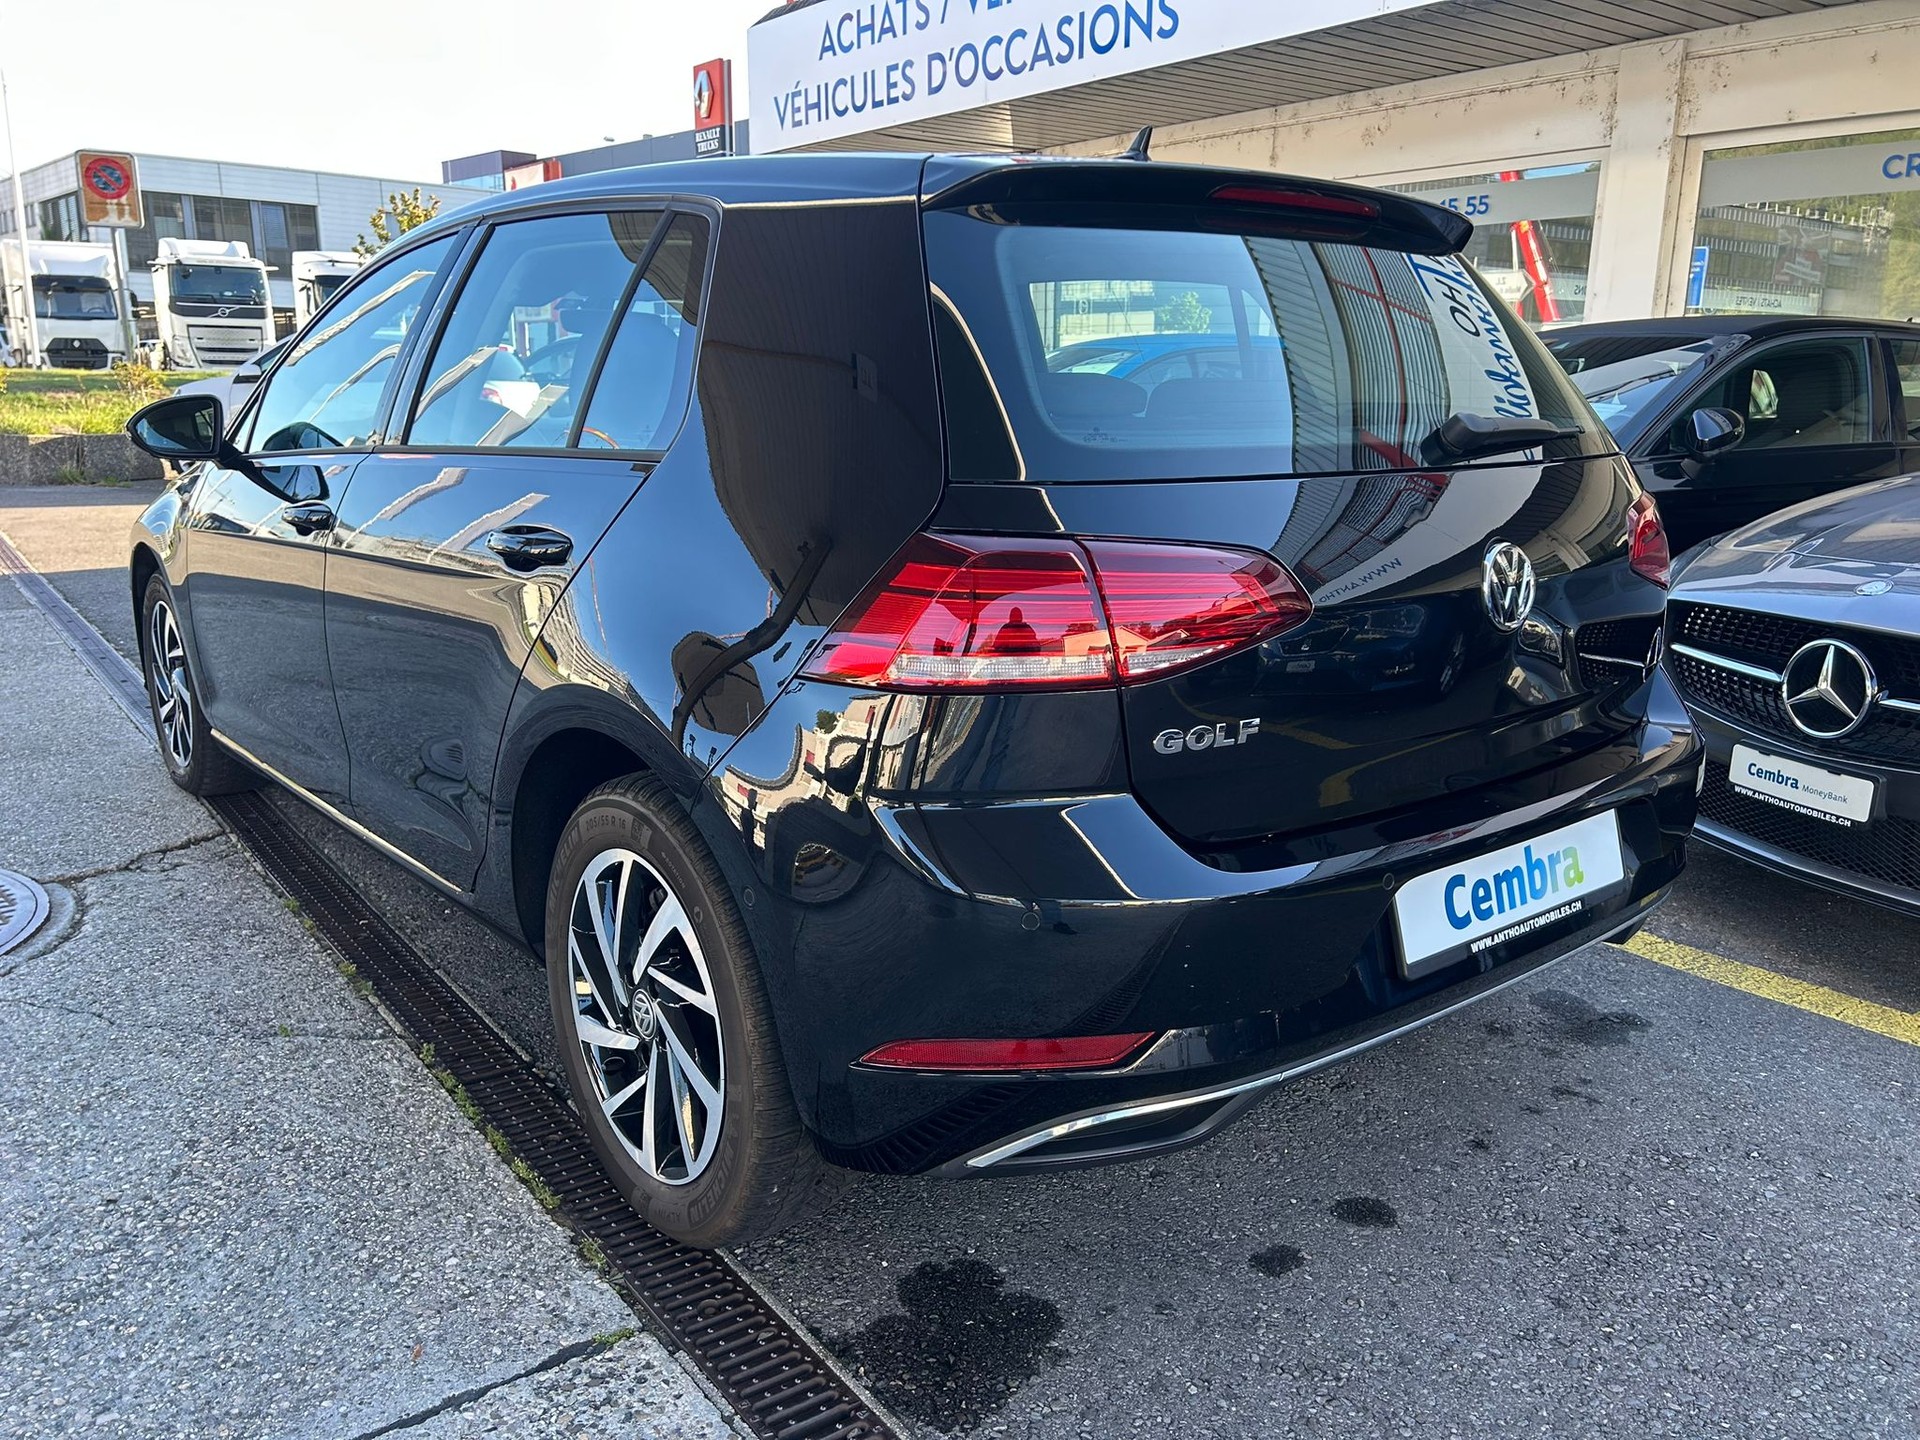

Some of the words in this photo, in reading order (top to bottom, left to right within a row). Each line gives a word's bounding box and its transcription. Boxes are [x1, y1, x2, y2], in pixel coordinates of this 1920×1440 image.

[819, 0, 931, 61] ACHATS
[774, 59, 916, 130] VÉHICULES
[927, 0, 1179, 96] D'OCCASIONS
[697, 139, 719, 152] TRUCKS
[1464, 194, 1489, 216] 55
[1152, 717, 1261, 755] GOLF
[1748, 762, 1799, 790] Cembra
[1801, 784, 1849, 804] MoneyBank
[1734, 784, 1851, 828] WWW.ANTHOAUTOMOBILES.CH
[1444, 844, 1585, 931] Cembra
[1470, 900, 1583, 954] WWW.ANTHOAUTOMOBILES.CH
